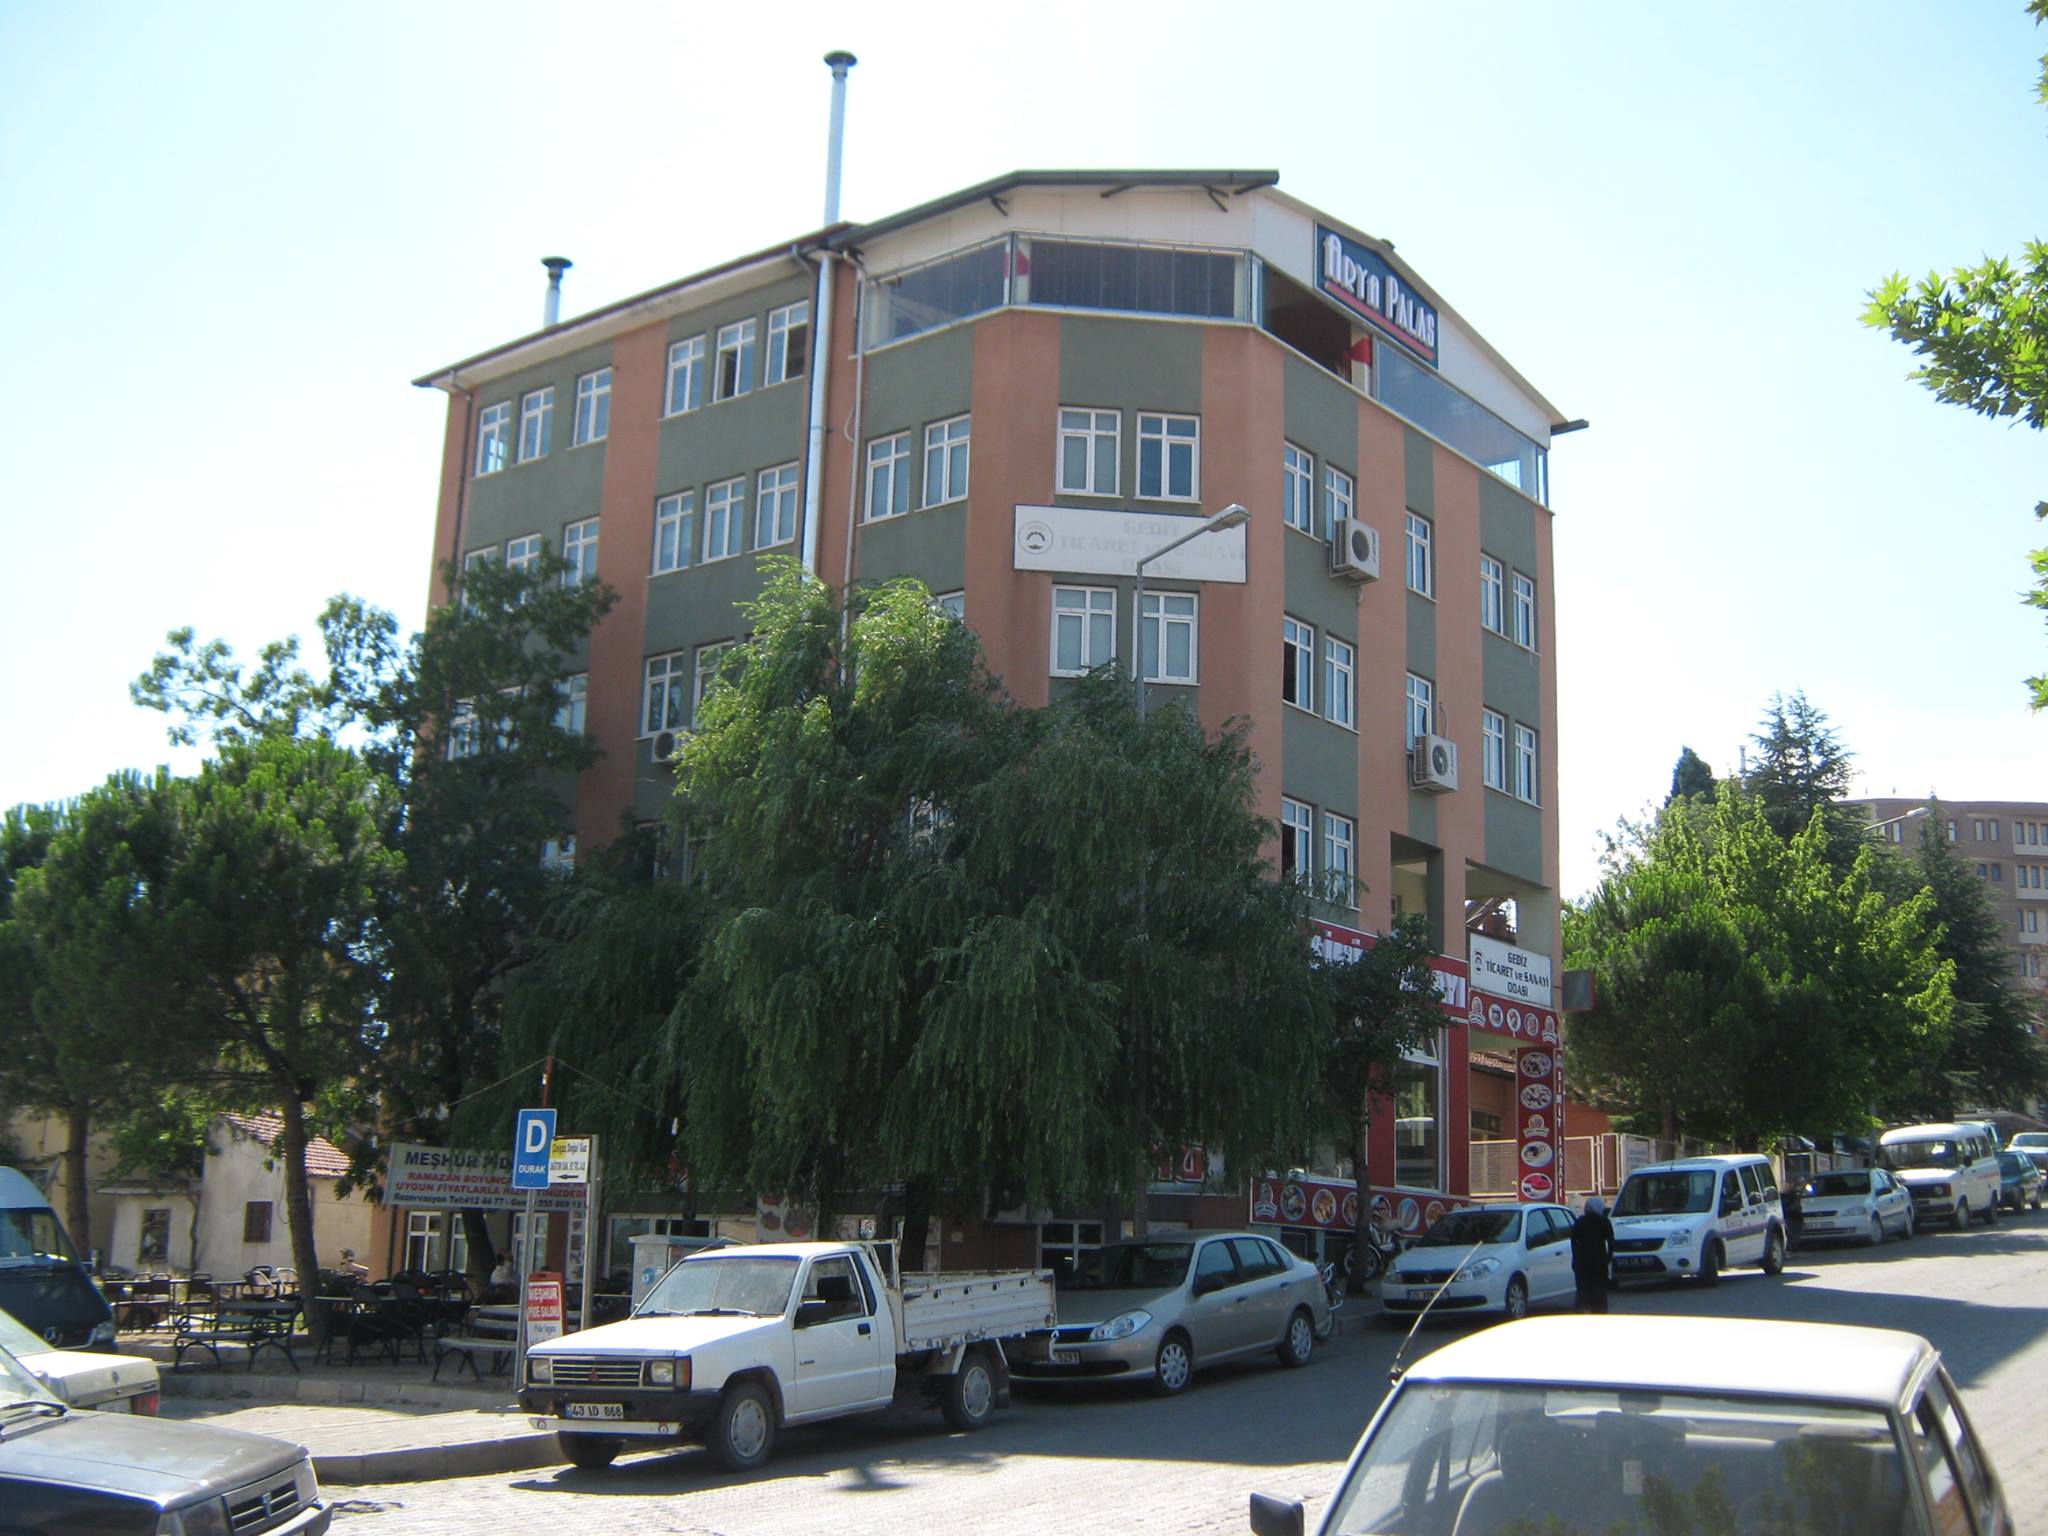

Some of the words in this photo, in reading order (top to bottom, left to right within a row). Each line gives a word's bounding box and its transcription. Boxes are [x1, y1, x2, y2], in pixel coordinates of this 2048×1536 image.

[1385, 275, 1435, 347] PALAS
[1507, 952, 1528, 968] GEDİZ
[1486, 959, 1514, 979] TİCARET
[1523, 971, 1550, 988] SANAYİ
[525, 1119, 547, 1153] D
[405, 1151, 478, 1169] MEŞHUR
[408, 1172, 460, 1183] RAMAZAN
[518, 1165, 546, 1174] DURAK
[396, 1182, 434, 1192] UYGUN
